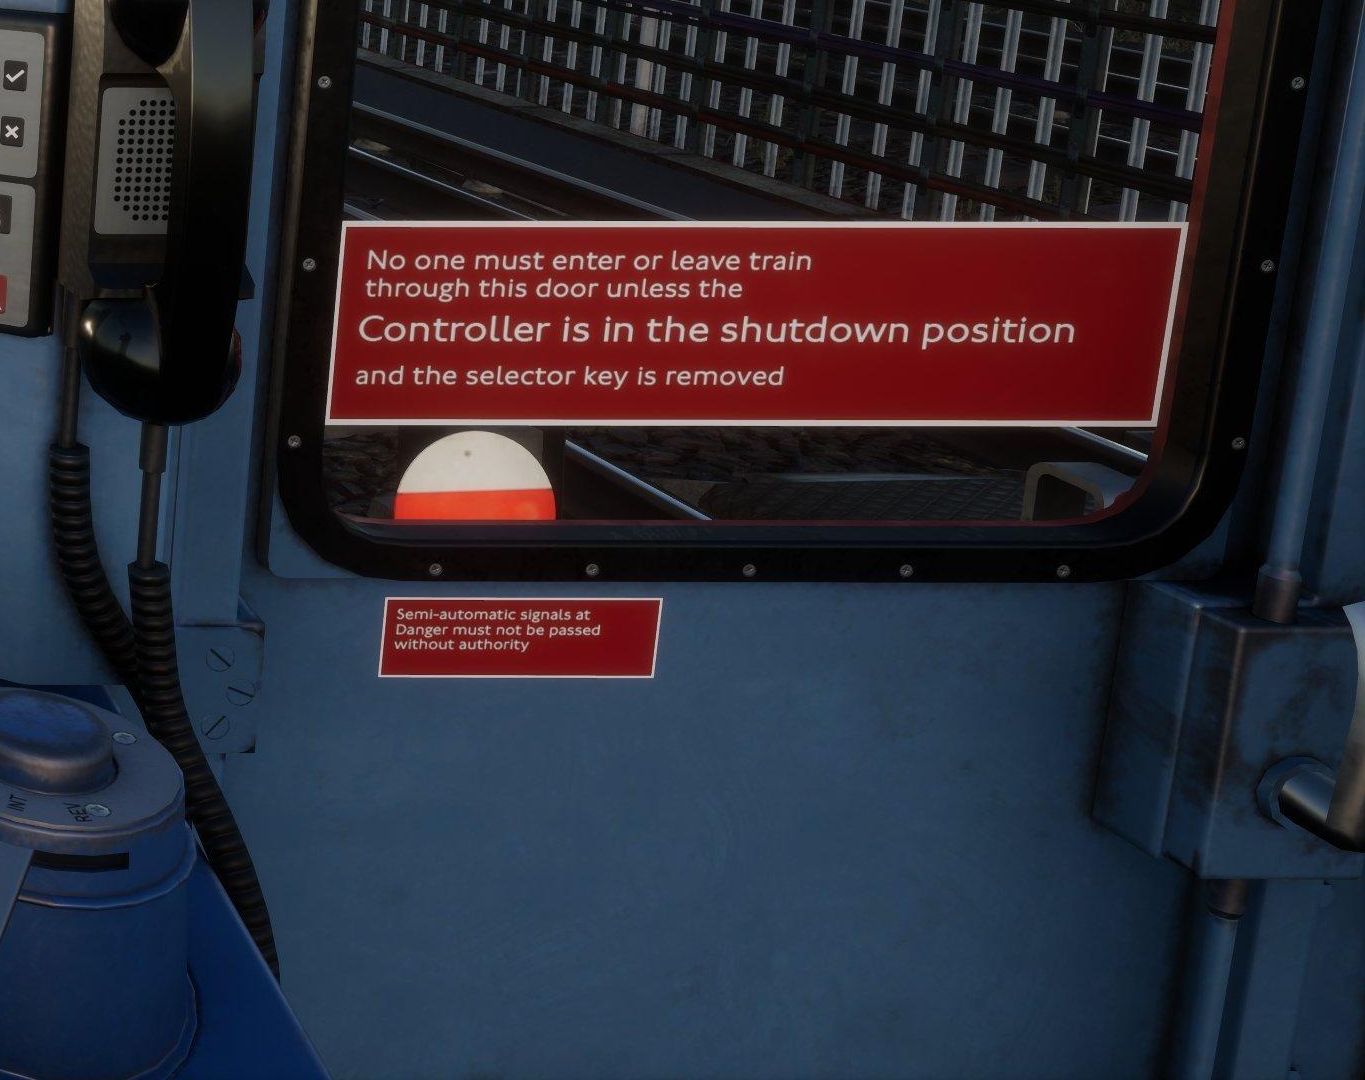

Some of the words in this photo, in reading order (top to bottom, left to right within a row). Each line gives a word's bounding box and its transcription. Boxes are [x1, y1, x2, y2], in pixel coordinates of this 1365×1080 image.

[367, 250, 405, 270] No
[415, 255, 465, 270] one
[475, 252, 545, 270] must
[553, 252, 626, 270] enter
[633, 255, 663, 270] or
[671, 250, 740, 270] leave
[749, 251, 811, 271] train
[366, 278, 469, 302] through
[479, 278, 527, 297] this
[536, 278, 599, 297] door
[607, 278, 690, 298] unless
[699, 278, 742, 298] the
[359, 315, 551, 342] Controller
[563, 316, 589, 342] is
[603, 316, 633, 342] in
[647, 316, 709, 342] the
[721, 316, 909, 343] shutdown
[922, 317, 1074, 350] position
[356, 365, 404, 385] and
[413, 365, 457, 385] the
[466, 366, 576, 385] selector
[584, 366, 629, 390] key
[638, 367, 656, 385] is
[666, 366, 784, 386] removed
[397, 608, 516, 620] Semi-automatic
[520, 609, 571, 622] signals
[576, 610, 590, 620] at
[396, 624, 448, 638] Danger
[453, 625, 490, 635] must
[496, 625, 522, 635] not
[527, 624, 544, 635] be
[549, 625, 600, 638] passed
[395, 639, 454, 650] without
[459, 639, 529, 652] authority
